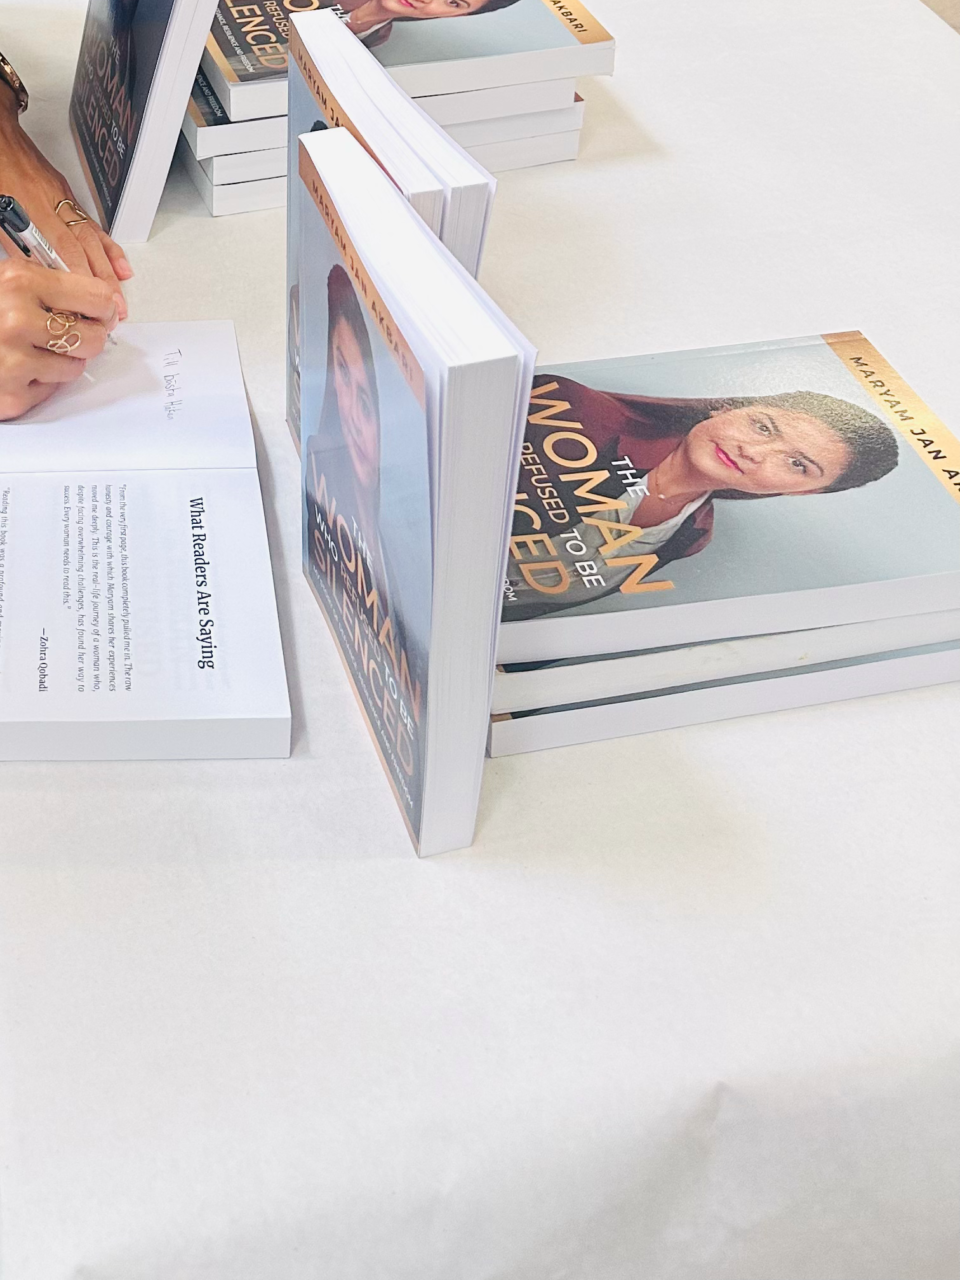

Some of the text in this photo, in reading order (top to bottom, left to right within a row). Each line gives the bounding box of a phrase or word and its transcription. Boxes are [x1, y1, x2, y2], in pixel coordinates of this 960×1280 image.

[550, 0, 588, 33] AKBARI
[312, 179, 413, 382] MARYAM JAN AKBARI
[849, 356, 947, 461] MARYAM JAN
[611, 455, 651, 498] THE
[527, 381, 675, 594] WOMAN
[62, 506, 71, 522] Every
[92, 504, 98, 513] me
[105, 506, 113, 518] and
[119, 502, 127, 511] the
[118, 511, 126, 524] very
[0, 530, 8, 546] book
[104, 519, 112, 543] courage
[118, 523, 128, 536] first
[92, 537, 100, 550] This
[106, 545, 114, 560] with
[119, 536, 127, 553] page,
[352, 515, 373, 574] THE
[63, 548, 71, 566] needs
[92, 559, 100, 570] the
[121, 554, 129, 566] this
[559, 528, 587, 556] TO
[575, 560, 607, 588] BE
[107, 561, 115, 581] which
[121, 566, 129, 582] book
[63, 575, 71, 590] read
[75, 485, 86, 692] despite facing overwhelming challenges, has found her way to
[91, 571, 101, 599] real-life
[190, 497, 217, 669] What Readers Are Saying
[311, 452, 421, 727] WOMAN
[105, 582, 115, 610] Maryam
[121, 582, 131, 618] completely
[91, 600, 99, 627] journey
[108, 612, 116, 635] shares
[315, 504, 415, 740] WHO REFUSED TO BE
[91, 628, 101, 636] of
[108, 636, 116, 648] her
[124, 640, 130, 652] me
[314, 529, 413, 776] SILENCED
[37, 662, 48, 692] Qobadi
[106, 650, 116, 692] experiences
[124, 663, 133, 676] The
[92, 673, 102, 692] who,
